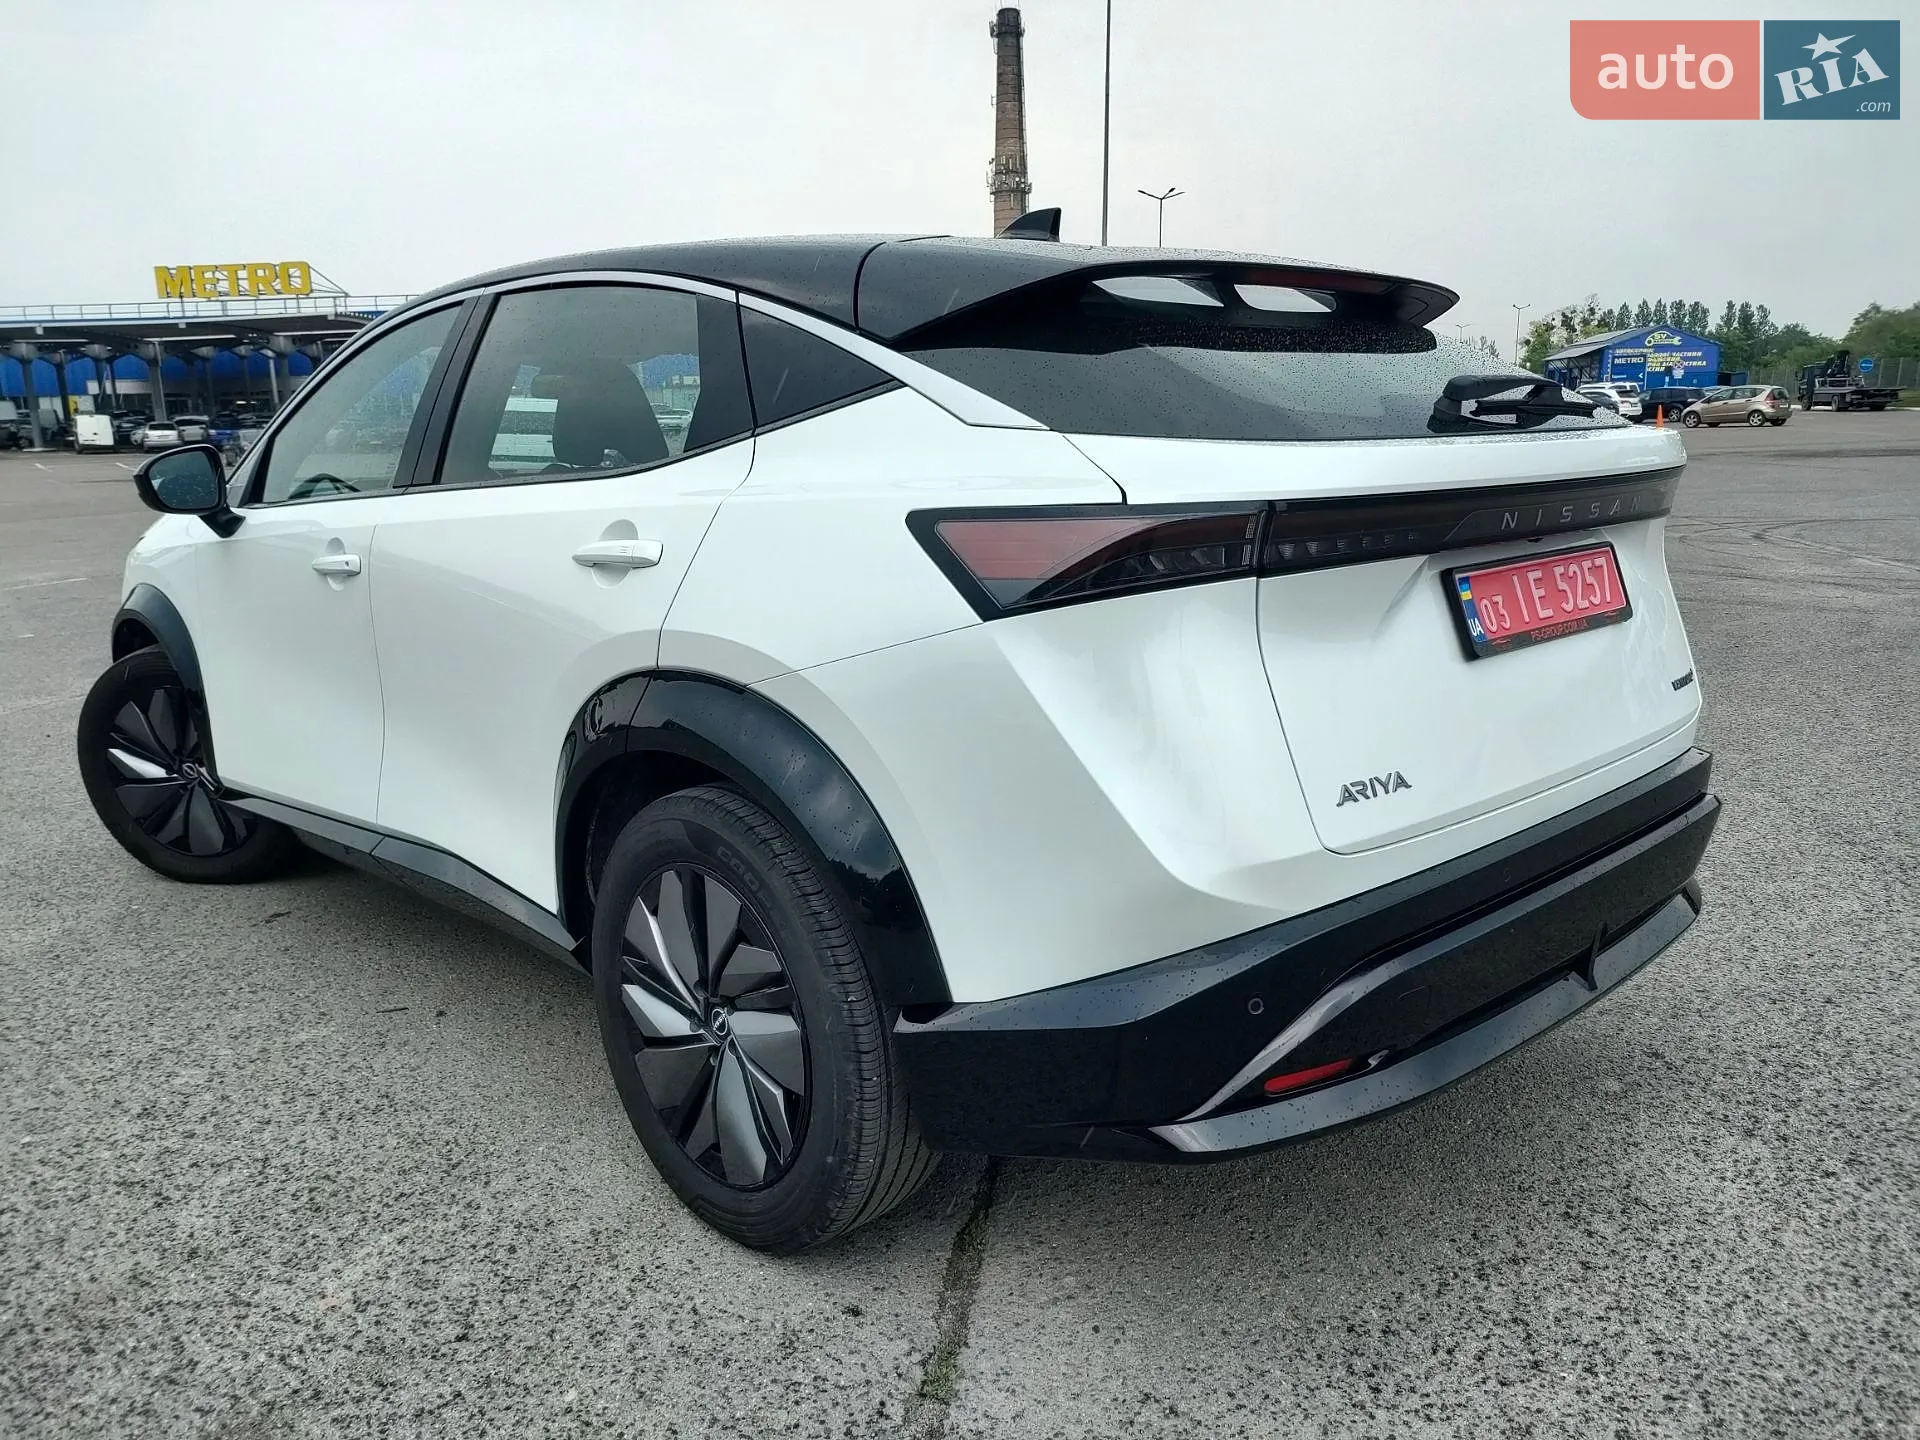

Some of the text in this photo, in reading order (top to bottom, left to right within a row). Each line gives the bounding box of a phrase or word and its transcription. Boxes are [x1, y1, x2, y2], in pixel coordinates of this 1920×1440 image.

[154, 261, 313, 299] METRO
[1614, 356, 1644, 364] METRO
[1501, 496, 1641, 530] NISSAN
[1480, 557, 1611, 633] 03 IE 5257
[1468, 618, 1485, 637] UA
[1336, 771, 1412, 807] ARIYA
